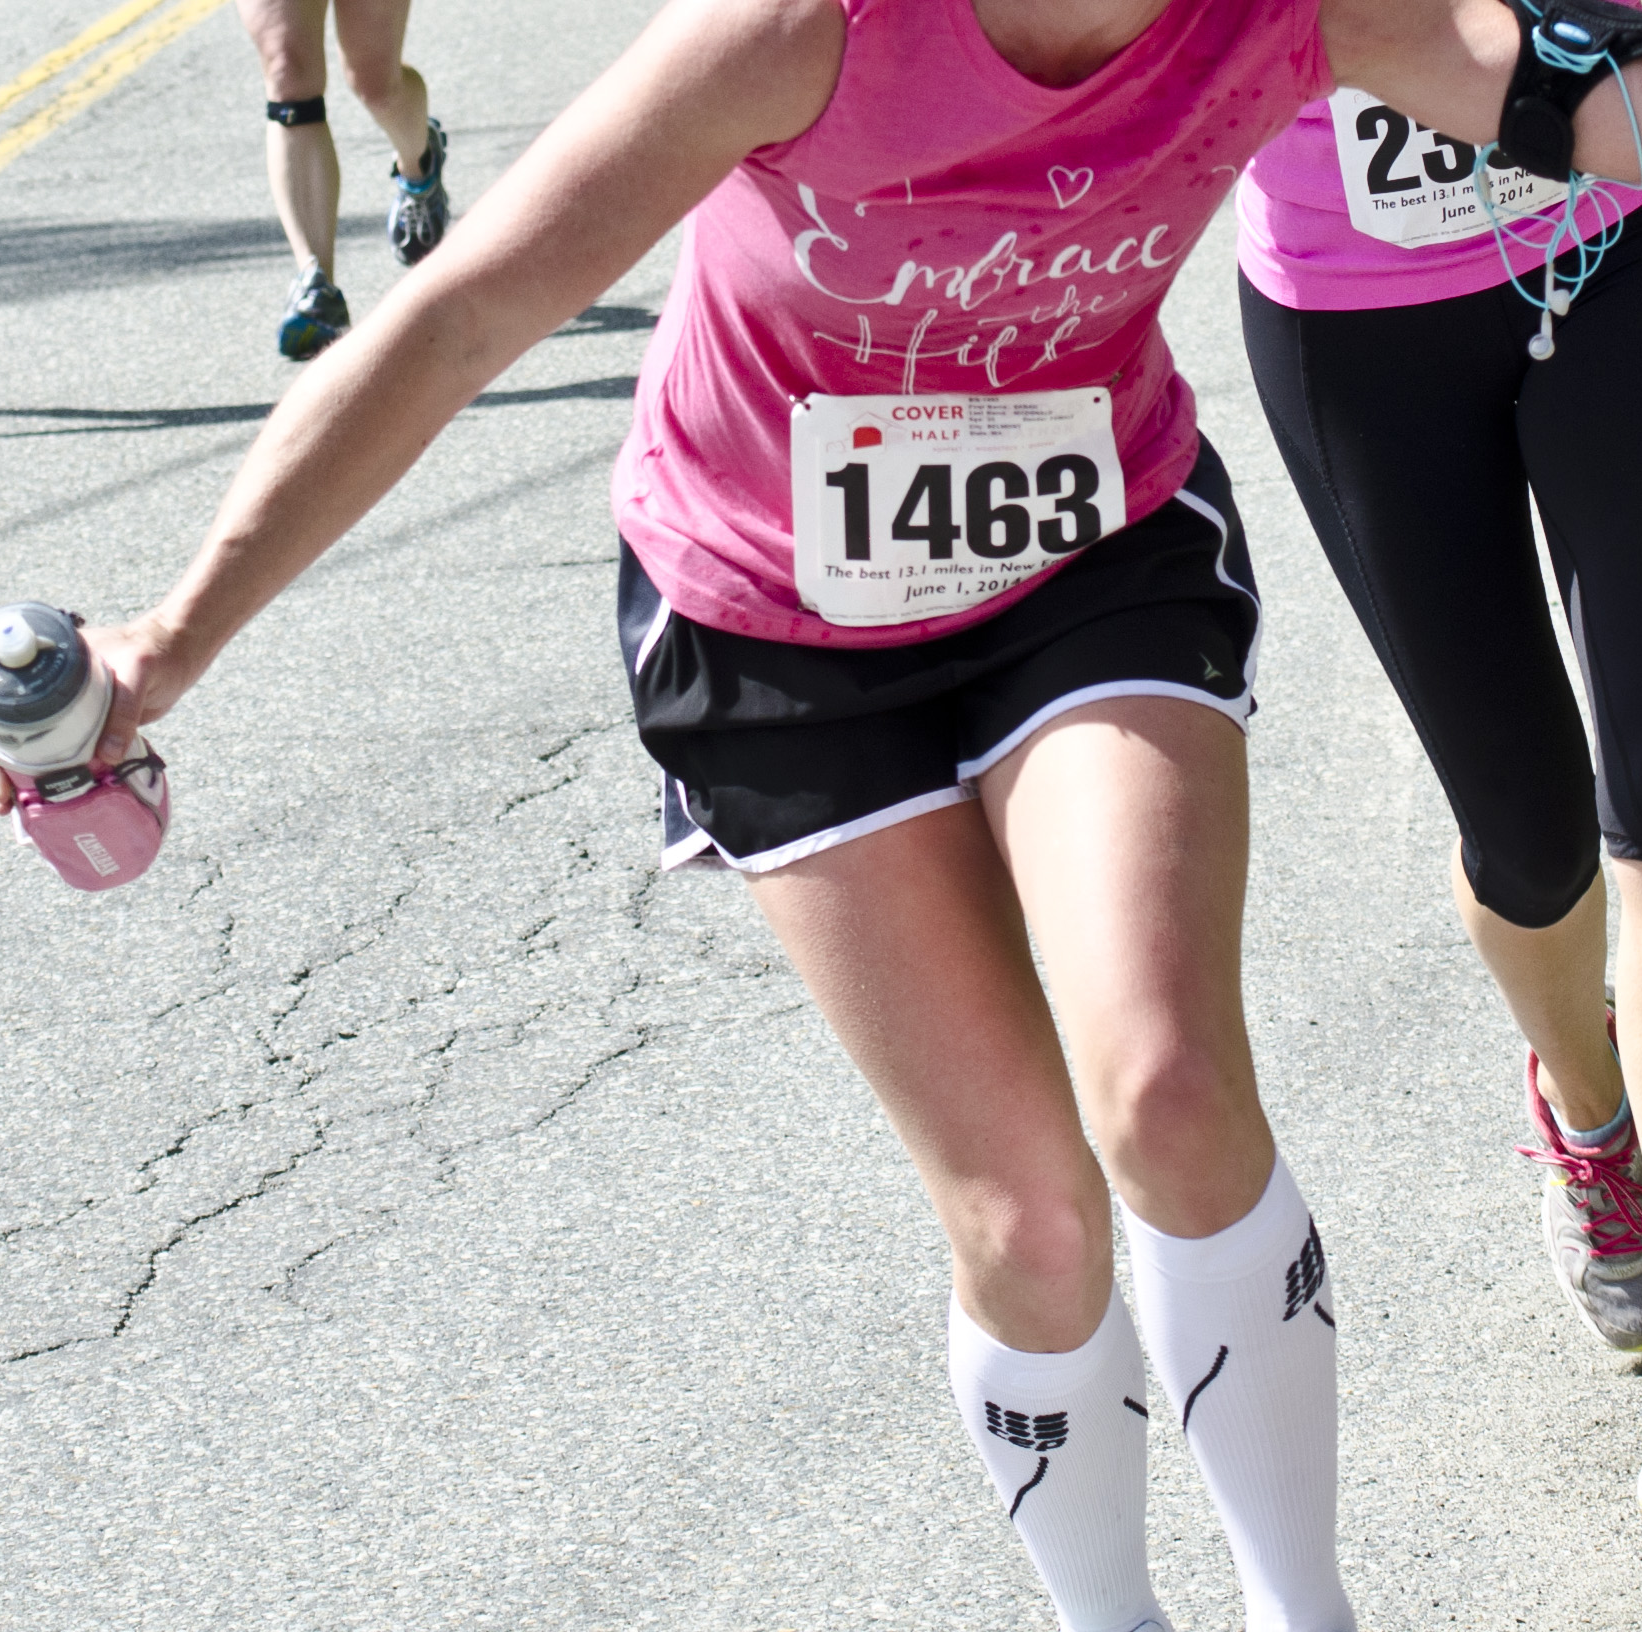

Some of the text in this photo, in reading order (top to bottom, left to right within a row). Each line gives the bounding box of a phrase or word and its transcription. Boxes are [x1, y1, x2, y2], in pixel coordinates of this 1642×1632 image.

[1372, 198, 1397, 212] The
[1401, 194, 1427, 208] best
[1433, 186, 1456, 202] 13.1
[1441, 205, 1476, 223] June
[1499, 183, 1535, 205] 2014
[793, 182, 1181, 311] Embrace
[911, 429, 961, 441] HALF
[825, 453, 1102, 561] 1463
[825, 564, 853, 579] The
[859, 567, 891, 580] best
[898, 564, 927, 579] 13.1
[934, 563, 974, 575] miles
[979, 564, 994, 574] in
[1000, 562, 1035, 573] New
[904, 576, 1021, 604] June 1, 2014
